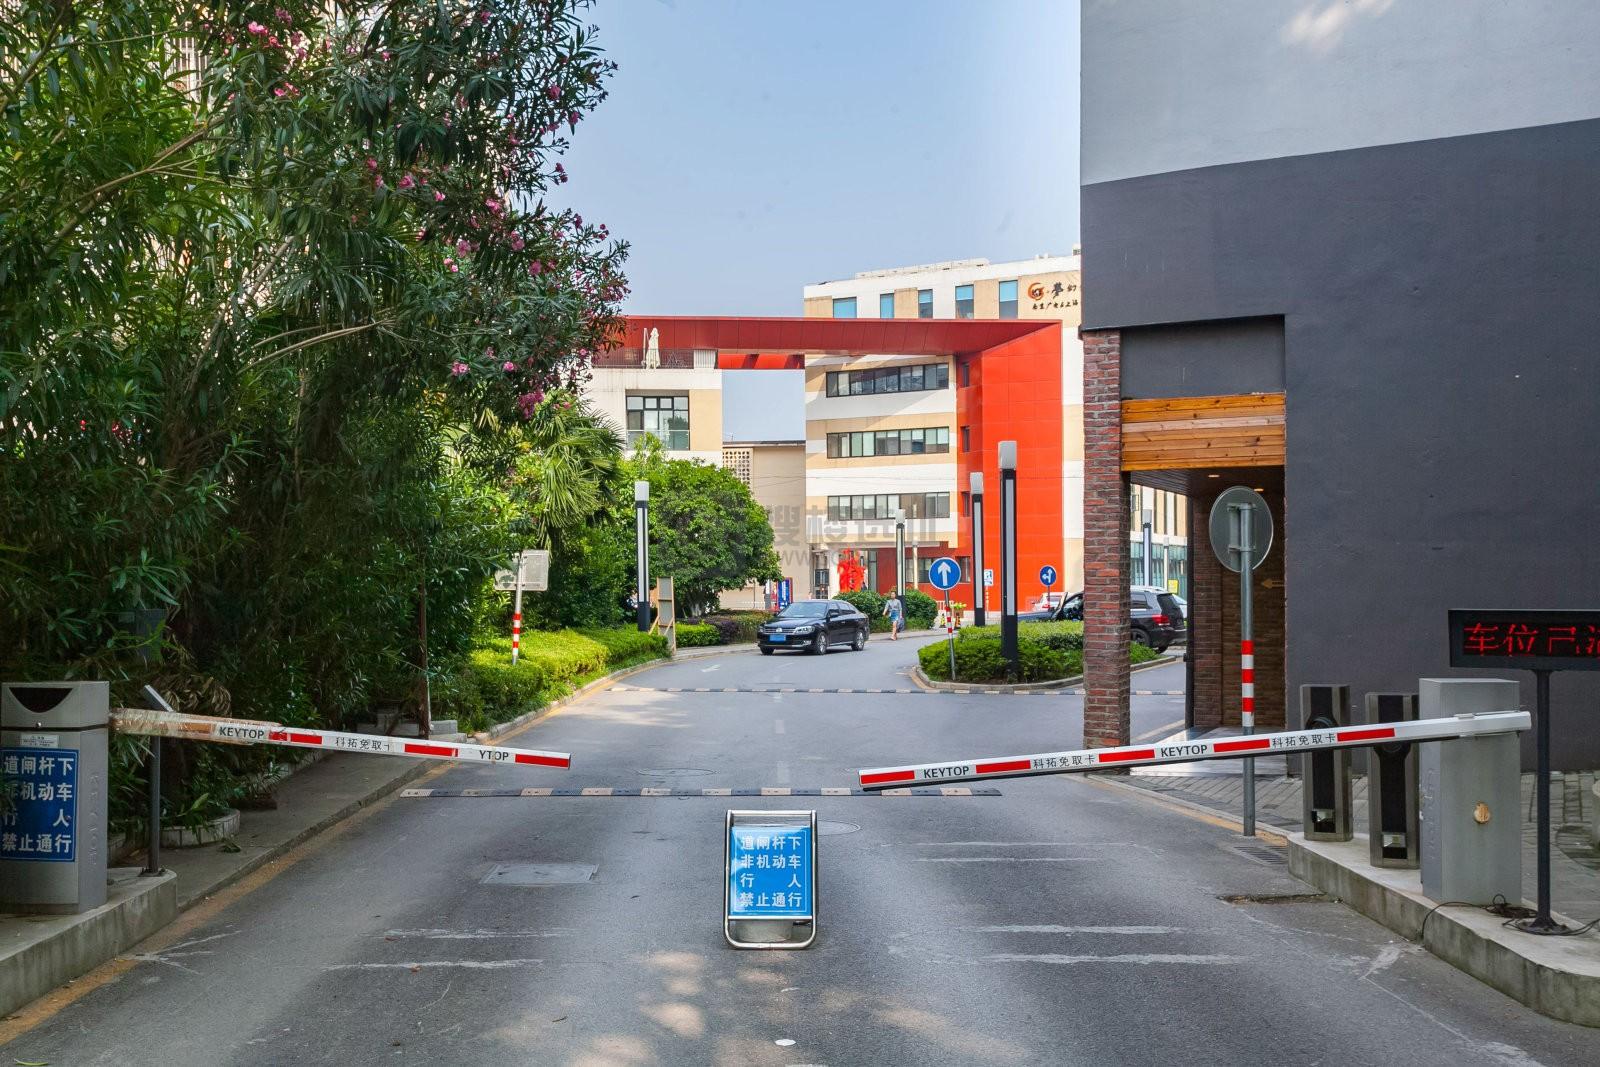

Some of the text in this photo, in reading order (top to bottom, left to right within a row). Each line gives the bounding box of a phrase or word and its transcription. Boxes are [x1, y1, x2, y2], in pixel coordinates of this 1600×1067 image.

[219, 726, 265, 739] KEYTOP
[480, 749, 509, 761] YTOP
[923, 732, 1336, 779] KEYTOP 科拓免取卡 KEYTOP 科拓免取卡
[4, 755, 74, 776] 道闸杆下
[53, 808, 69, 828] 人
[2, 834, 72, 853] 禁止通行
[741, 835, 802, 850] 道闸杆下
[741, 854, 801, 869] 非机动车
[741, 873, 801, 888] 行 人
[740, 892, 802, 908] 禁止通行
